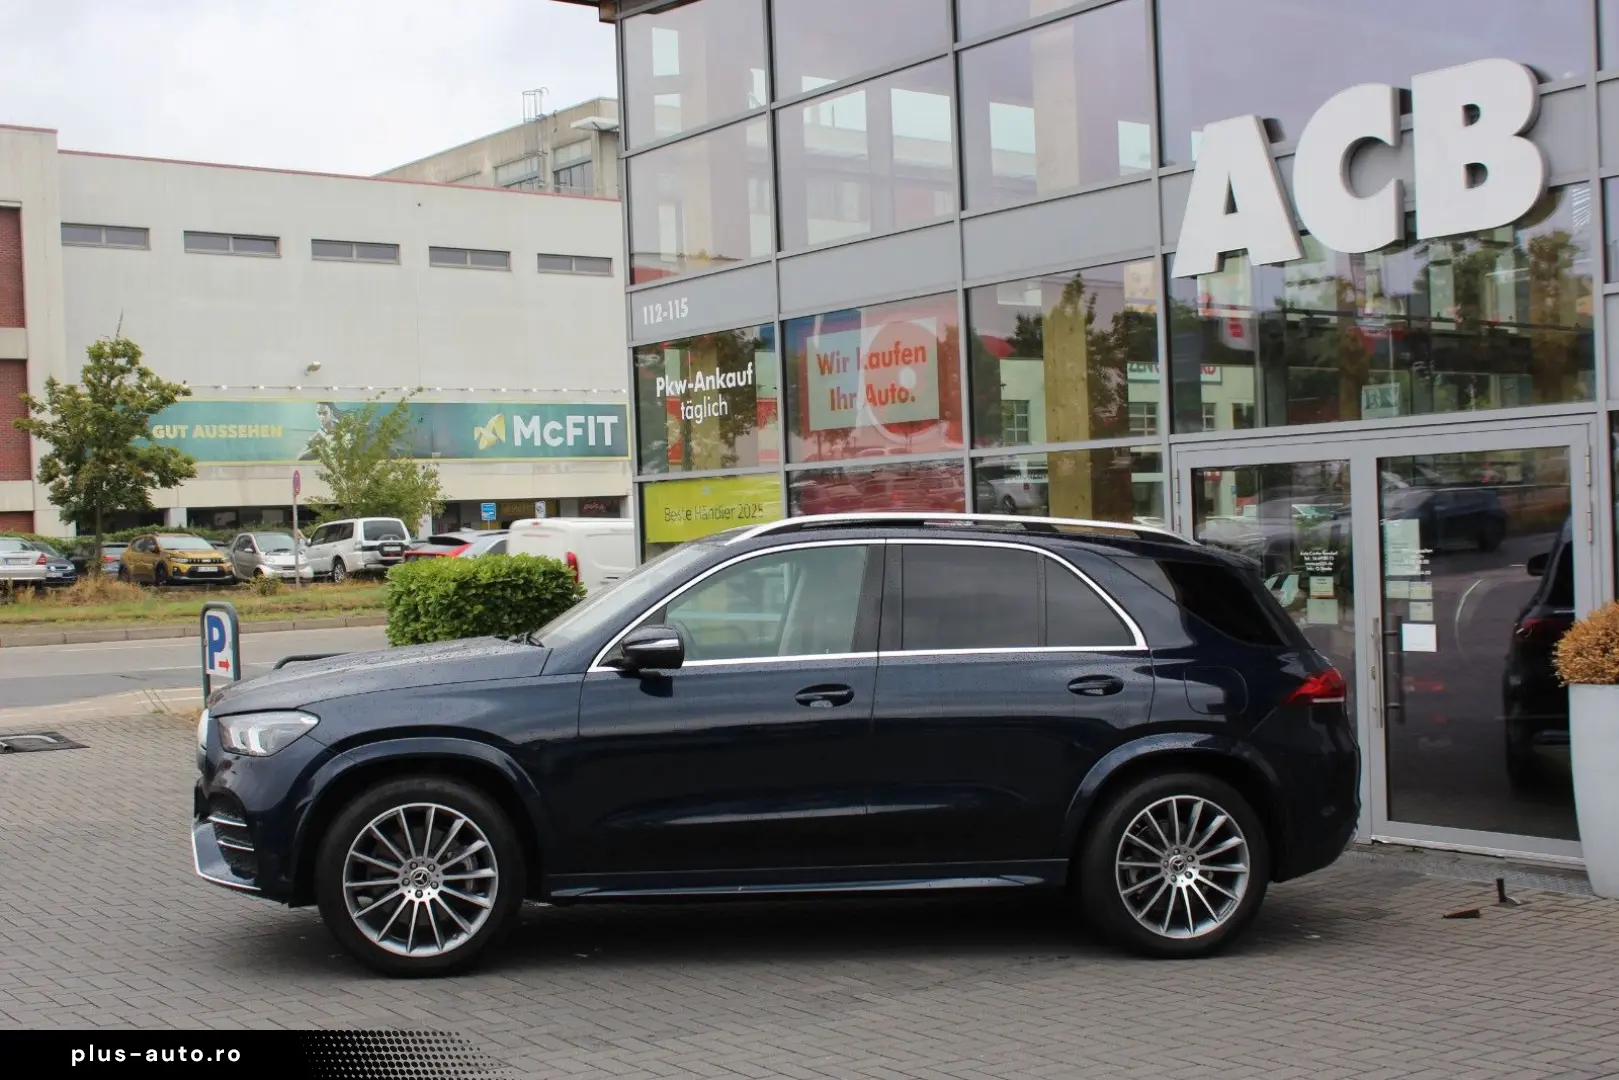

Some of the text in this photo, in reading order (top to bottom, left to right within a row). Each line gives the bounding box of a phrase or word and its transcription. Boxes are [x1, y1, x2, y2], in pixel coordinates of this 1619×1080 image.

[1171, 58, 1549, 279] ACB
[643, 297, 689, 325] 112-115
[816, 350, 850, 376] Wir
[656, 361, 753, 398] Pkw-Ankauf
[680, 393, 729, 424] täglich
[829, 382, 917, 412] Ihr Auto.
[152, 424, 283, 439] GUT AUSSEHEN
[513, 415, 619, 447] McFIT
[664, 502, 764, 522] Beste Händler 2025
[206, 614, 226, 670] P
